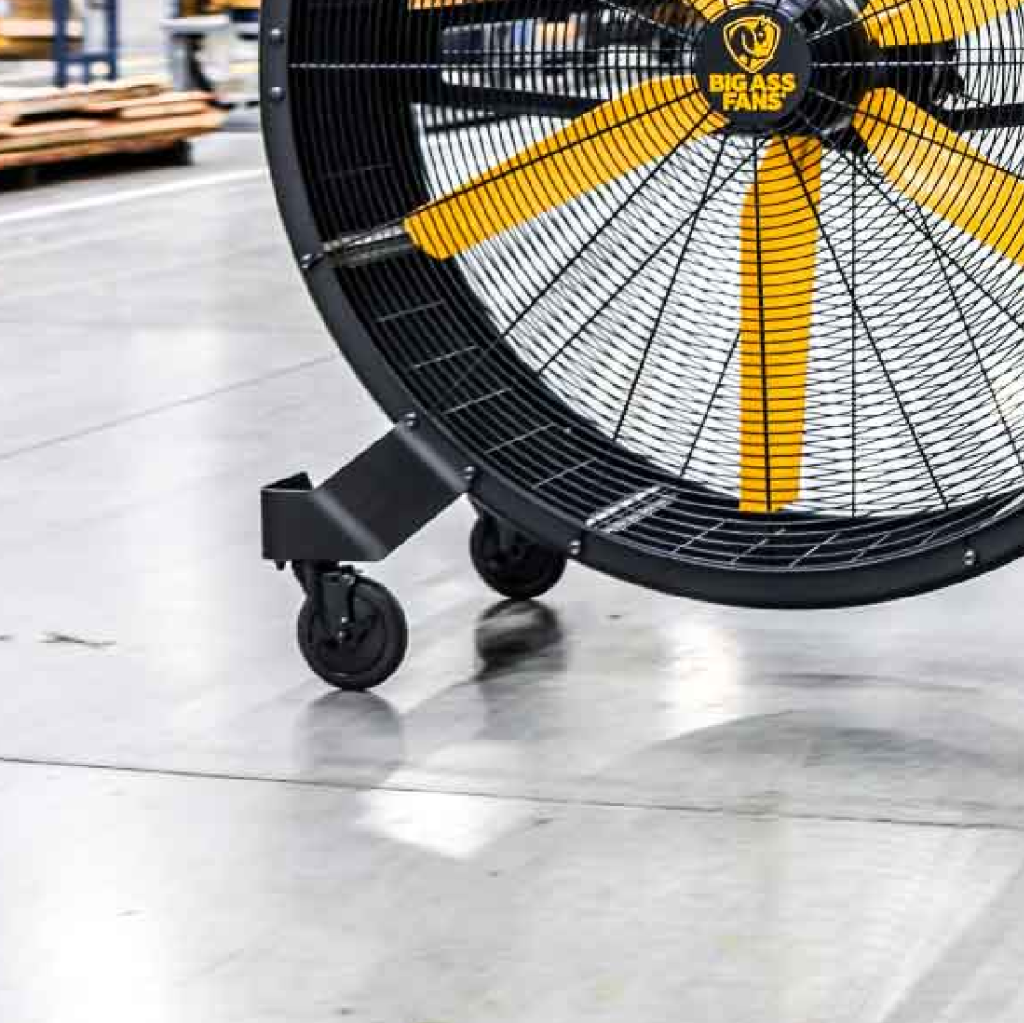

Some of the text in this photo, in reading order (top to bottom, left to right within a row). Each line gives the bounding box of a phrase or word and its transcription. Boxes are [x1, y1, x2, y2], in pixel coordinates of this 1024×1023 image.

[708, 73, 795, 92] BIG ASS
[723, 92, 783, 111] FANS
